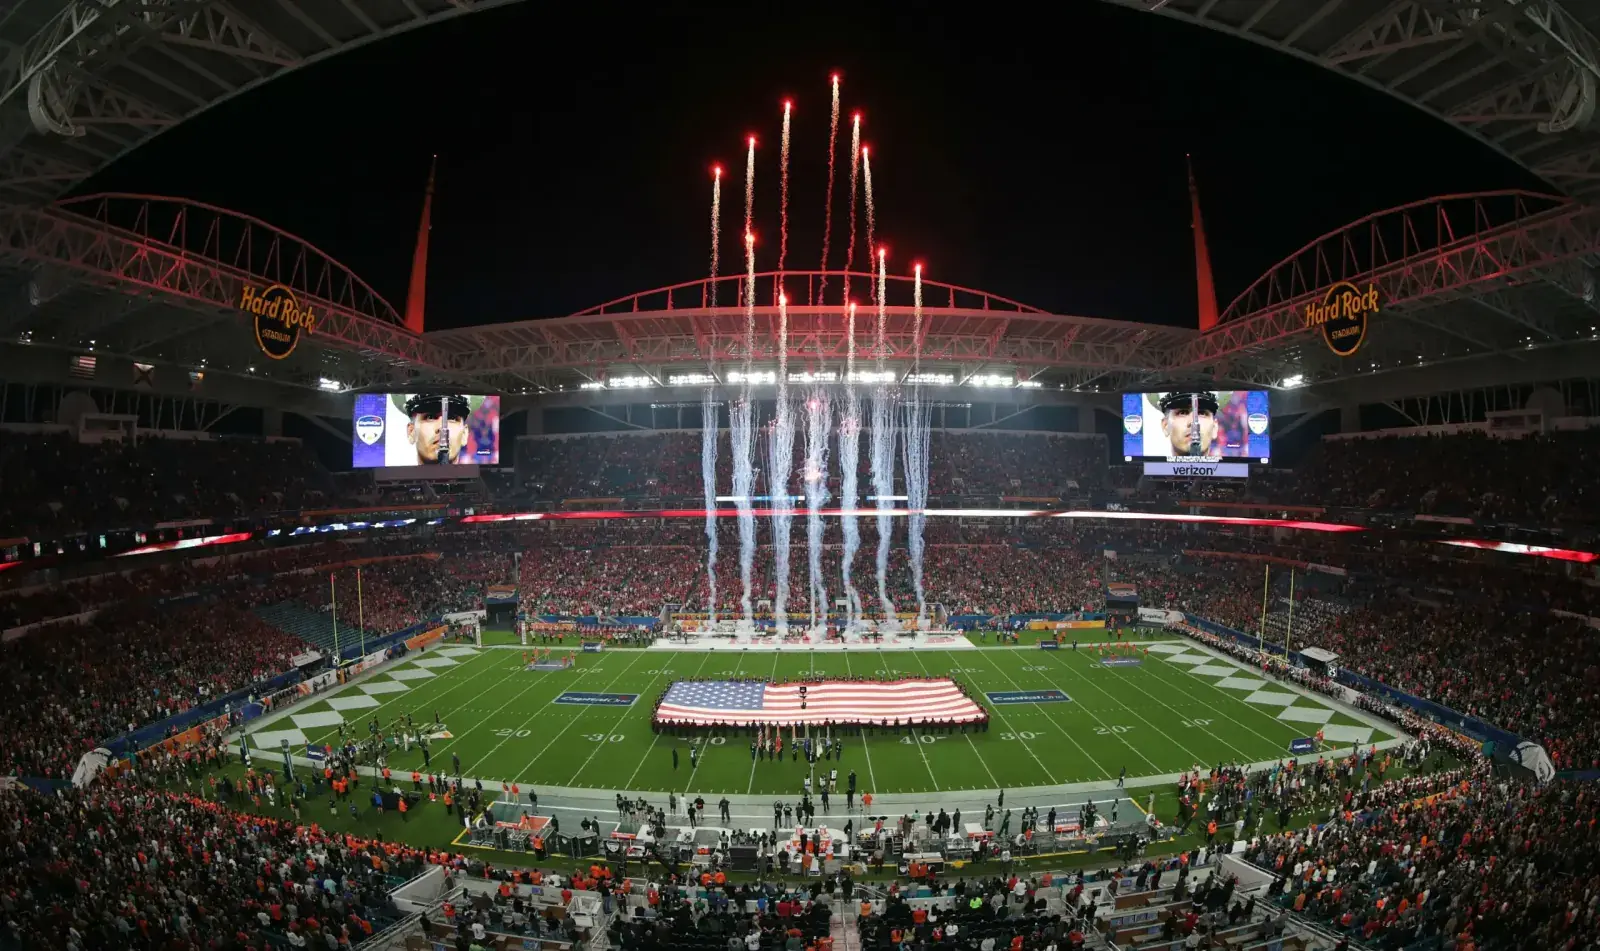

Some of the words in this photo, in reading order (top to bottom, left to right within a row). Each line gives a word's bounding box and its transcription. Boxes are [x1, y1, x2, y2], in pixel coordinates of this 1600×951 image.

[240, 285, 282, 319] Hard
[281, 298, 315, 335] Rock
[1305, 294, 1340, 328] Hard
[1342, 283, 1379, 320] Rock
[1173, 464, 1213, 476] verizon
[495, 728, 532, 738] 20
[1093, 725, 1128, 735] 20
[588, 733, 625, 743] 30
[900, 735, 936, 745] 40
[999, 731, 1036, 741] 30
